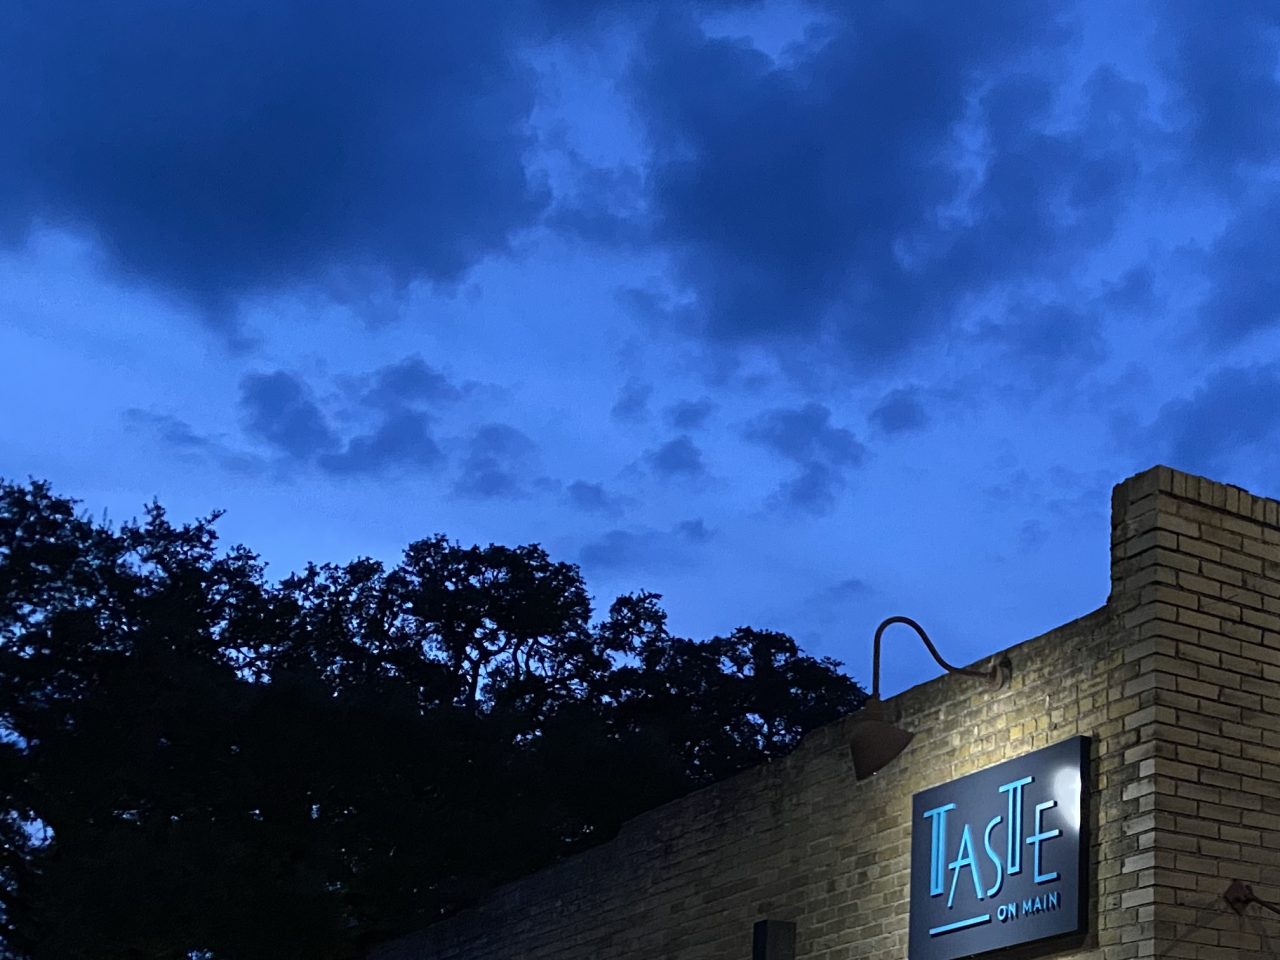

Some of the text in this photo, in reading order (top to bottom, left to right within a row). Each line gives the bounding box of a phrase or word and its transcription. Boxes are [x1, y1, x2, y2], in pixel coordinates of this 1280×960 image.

[923, 776, 1060, 908] TASTE
[997, 891, 1057, 921] ON MAIN
